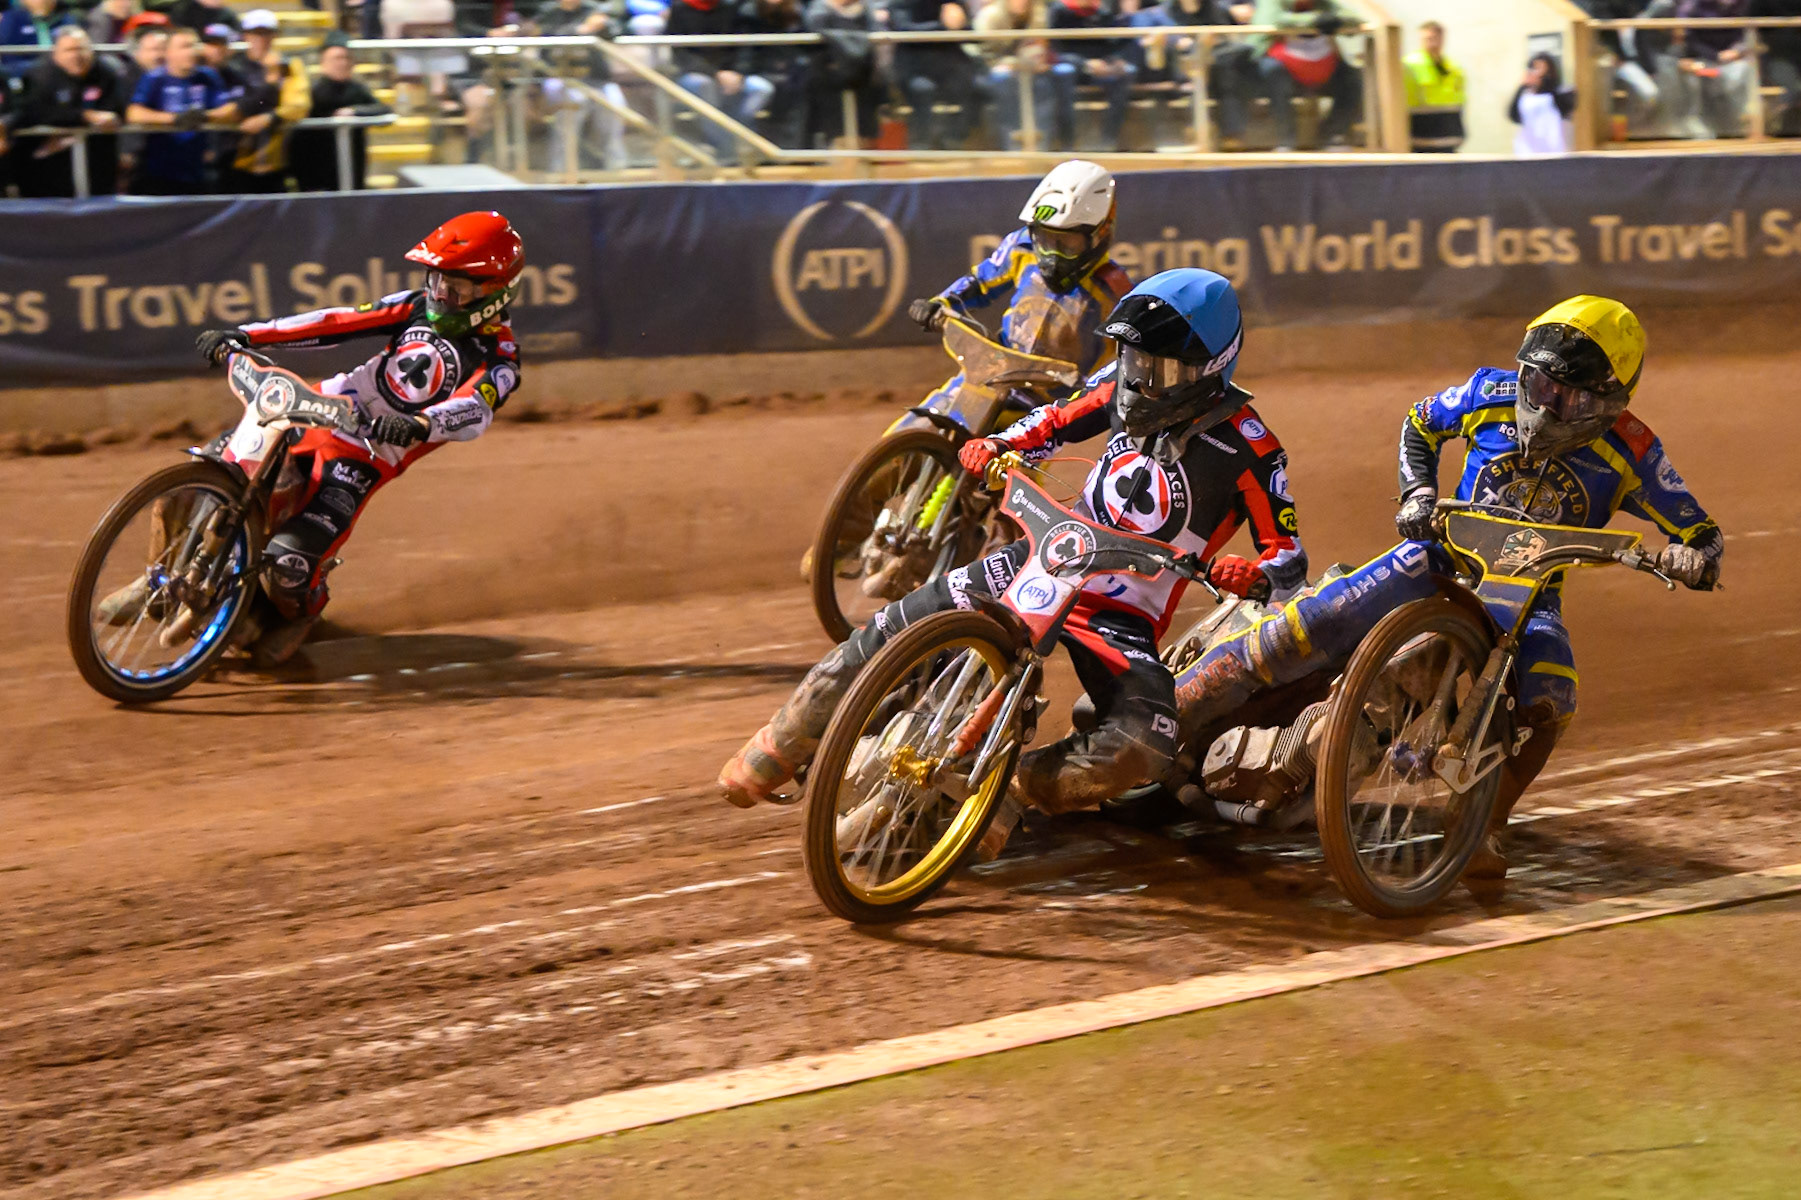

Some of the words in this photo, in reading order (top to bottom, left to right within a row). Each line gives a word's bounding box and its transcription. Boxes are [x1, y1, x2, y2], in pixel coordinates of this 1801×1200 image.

[1259, 218, 1422, 274] World
[1437, 215, 1580, 268] Class
[1588, 208, 1748, 263] Travel
[797, 247, 885, 292] ATPI
[67, 262, 272, 332] Travel
[289, 256, 578, 314] Soluns
[400, 331, 432, 346] ELLE
[1166, 471, 1185, 509] ACES
[1490, 458, 1583, 515] SHEFFIELD
[1023, 585, 1049, 602] ATPI
